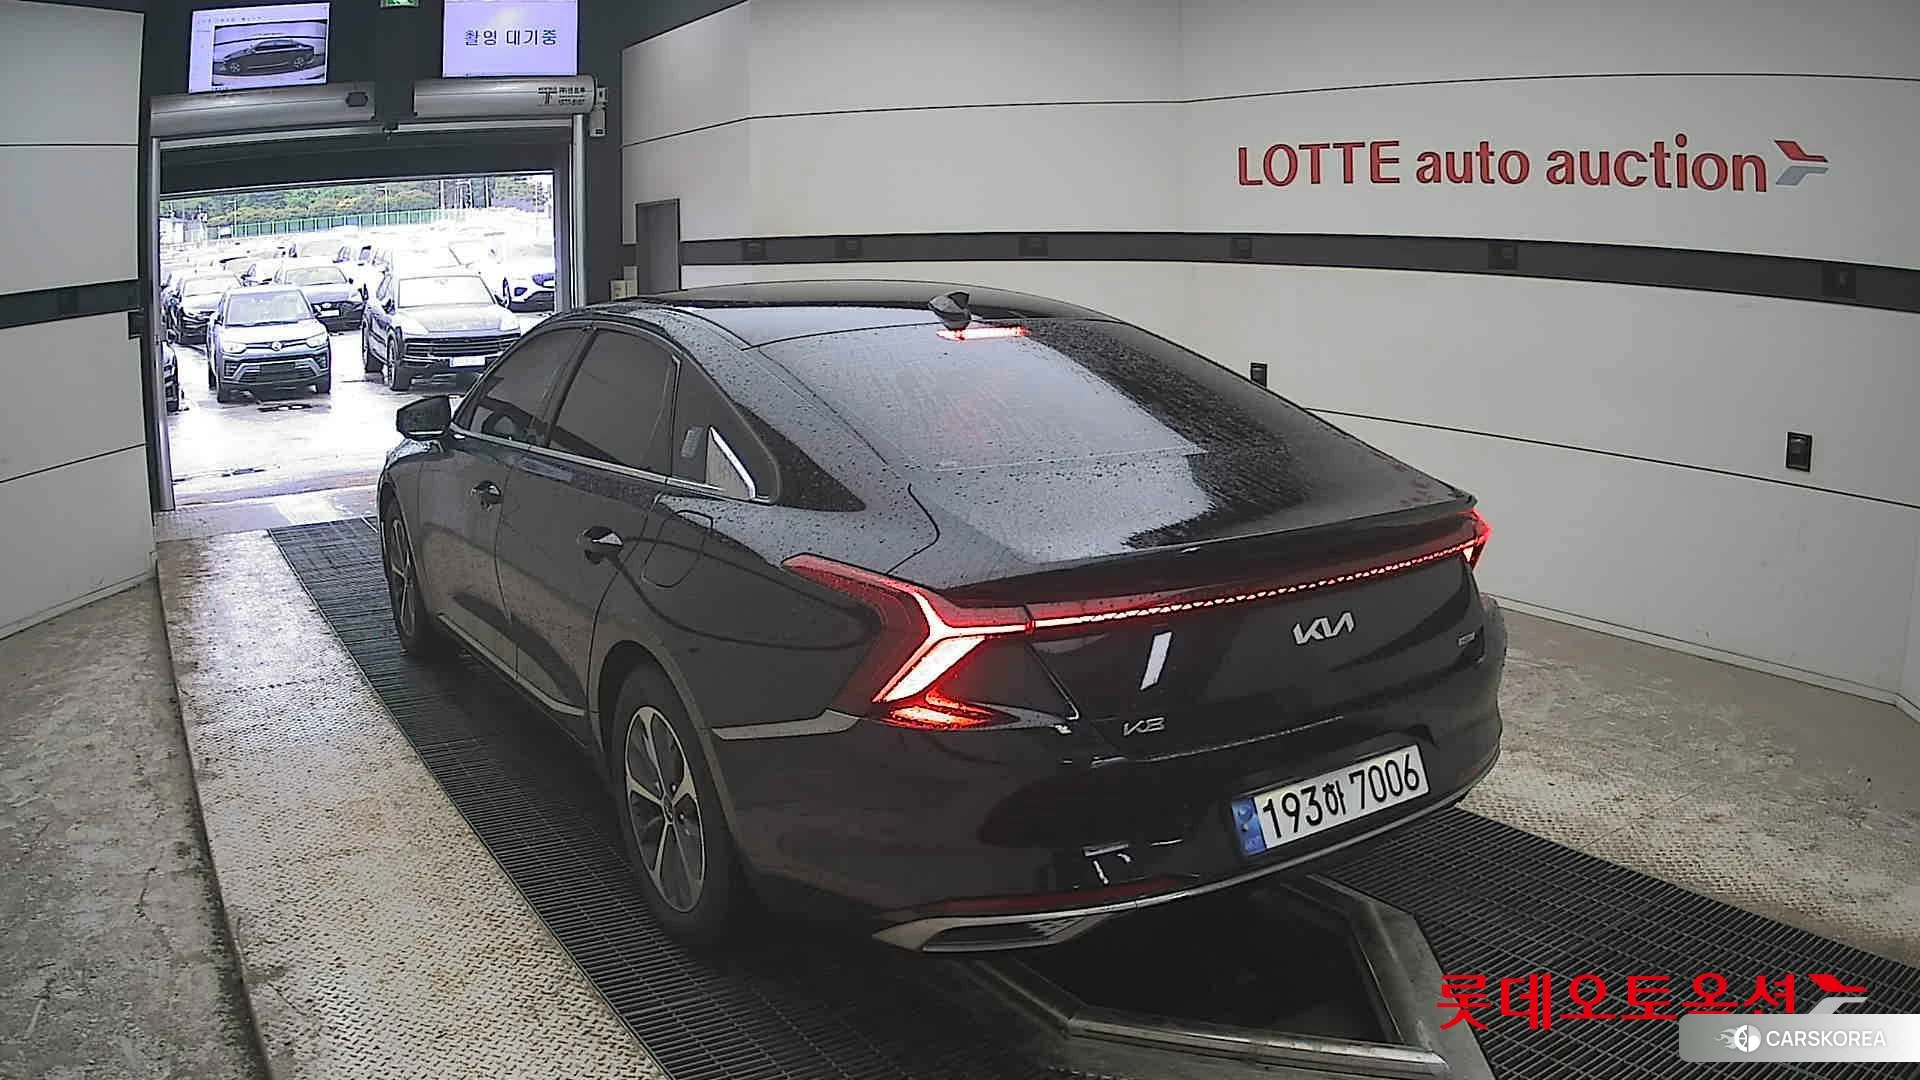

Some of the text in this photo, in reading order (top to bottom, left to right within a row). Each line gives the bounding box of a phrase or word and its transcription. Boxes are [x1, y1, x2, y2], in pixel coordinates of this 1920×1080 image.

[505, 28, 558, 47] 대기중
[1237, 132, 1768, 193] LOTTE auto auction
[1292, 611, 1355, 646] KIA
[1262, 752, 1420, 839] 193하 7006
